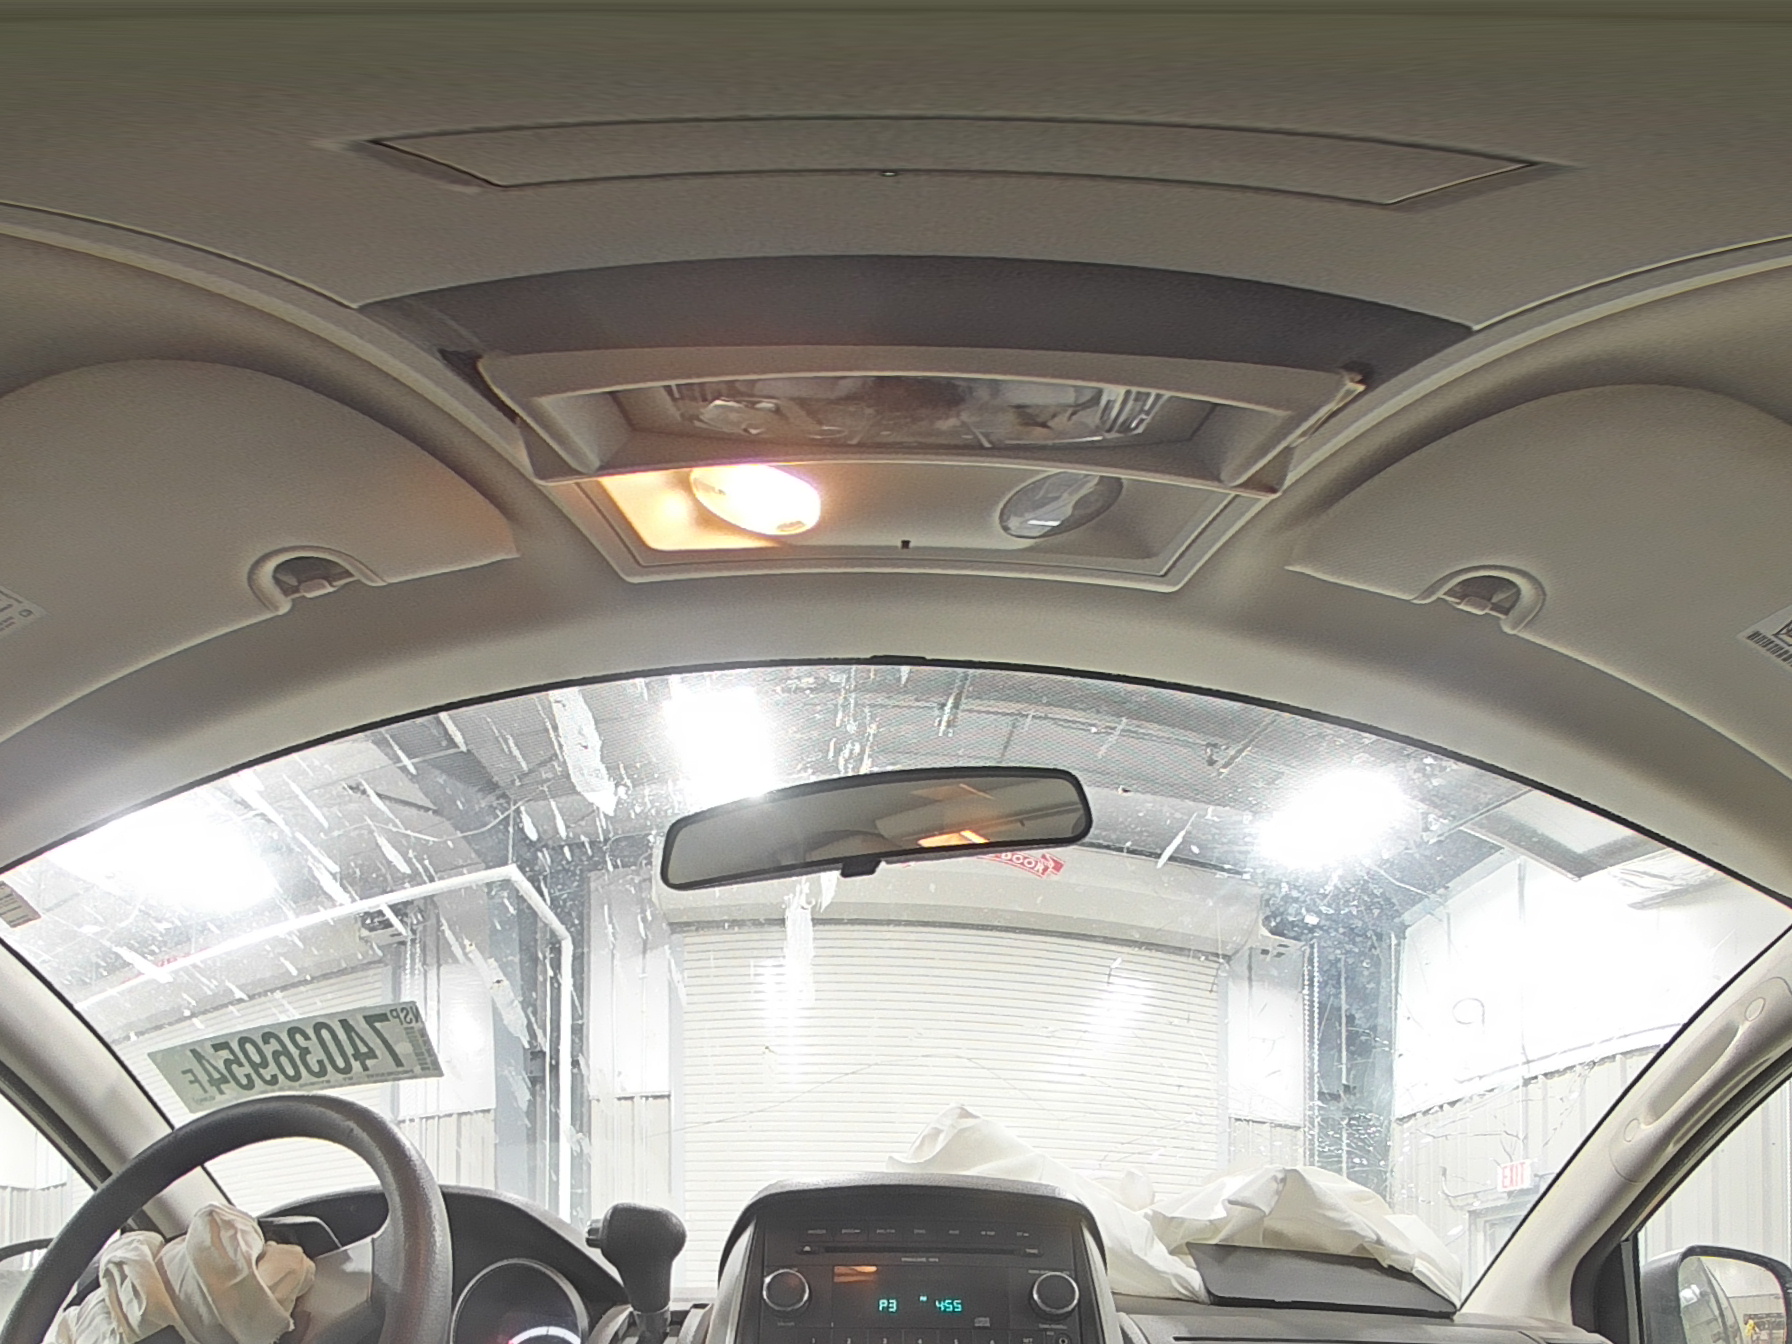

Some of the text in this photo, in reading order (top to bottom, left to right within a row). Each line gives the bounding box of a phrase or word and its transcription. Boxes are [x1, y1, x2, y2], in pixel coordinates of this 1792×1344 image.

[1001, 852, 1045, 875] DOOR
[1502, 1162, 1526, 1189] EXIT
[879, 1299, 897, 1312] P3
